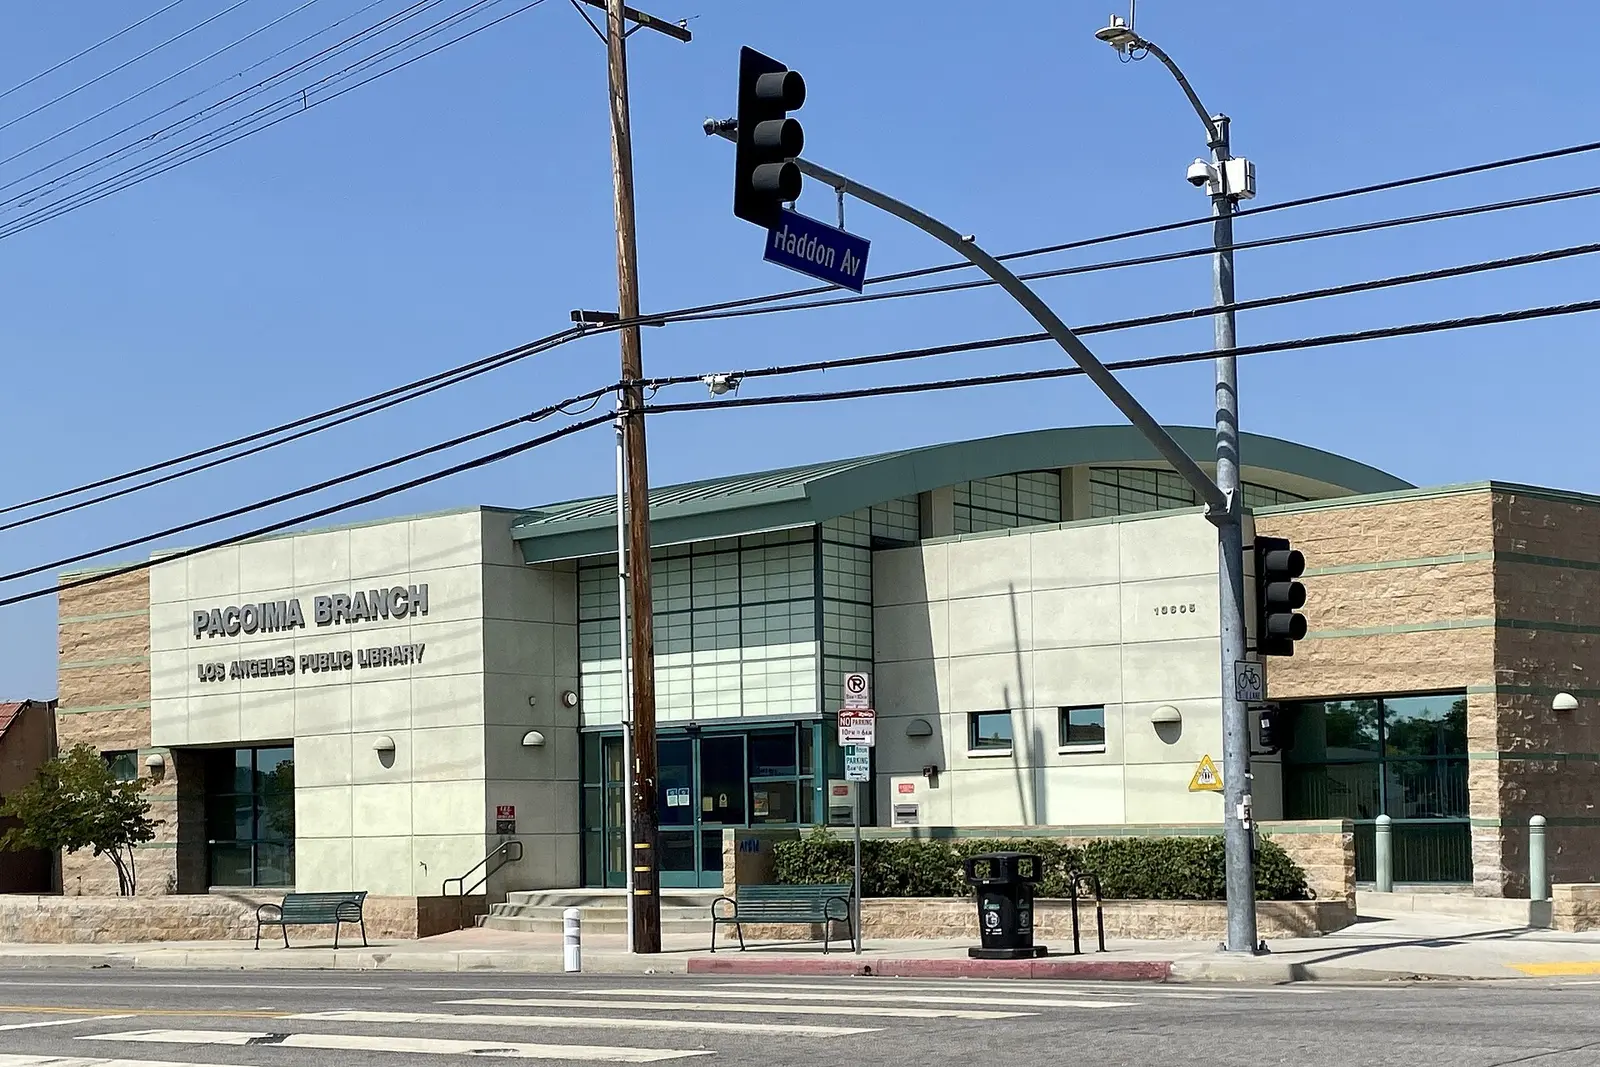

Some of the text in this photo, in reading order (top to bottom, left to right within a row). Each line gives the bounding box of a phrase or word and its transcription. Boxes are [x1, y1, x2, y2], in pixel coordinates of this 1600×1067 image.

[774, 225, 861, 276] Haddon Av
[193, 584, 429, 639] PACOIMA BRANCH
[197, 643, 426, 682] LOS ANGELES PUBLIC LIBRARY
[840, 718, 872, 726] NO PARKING
